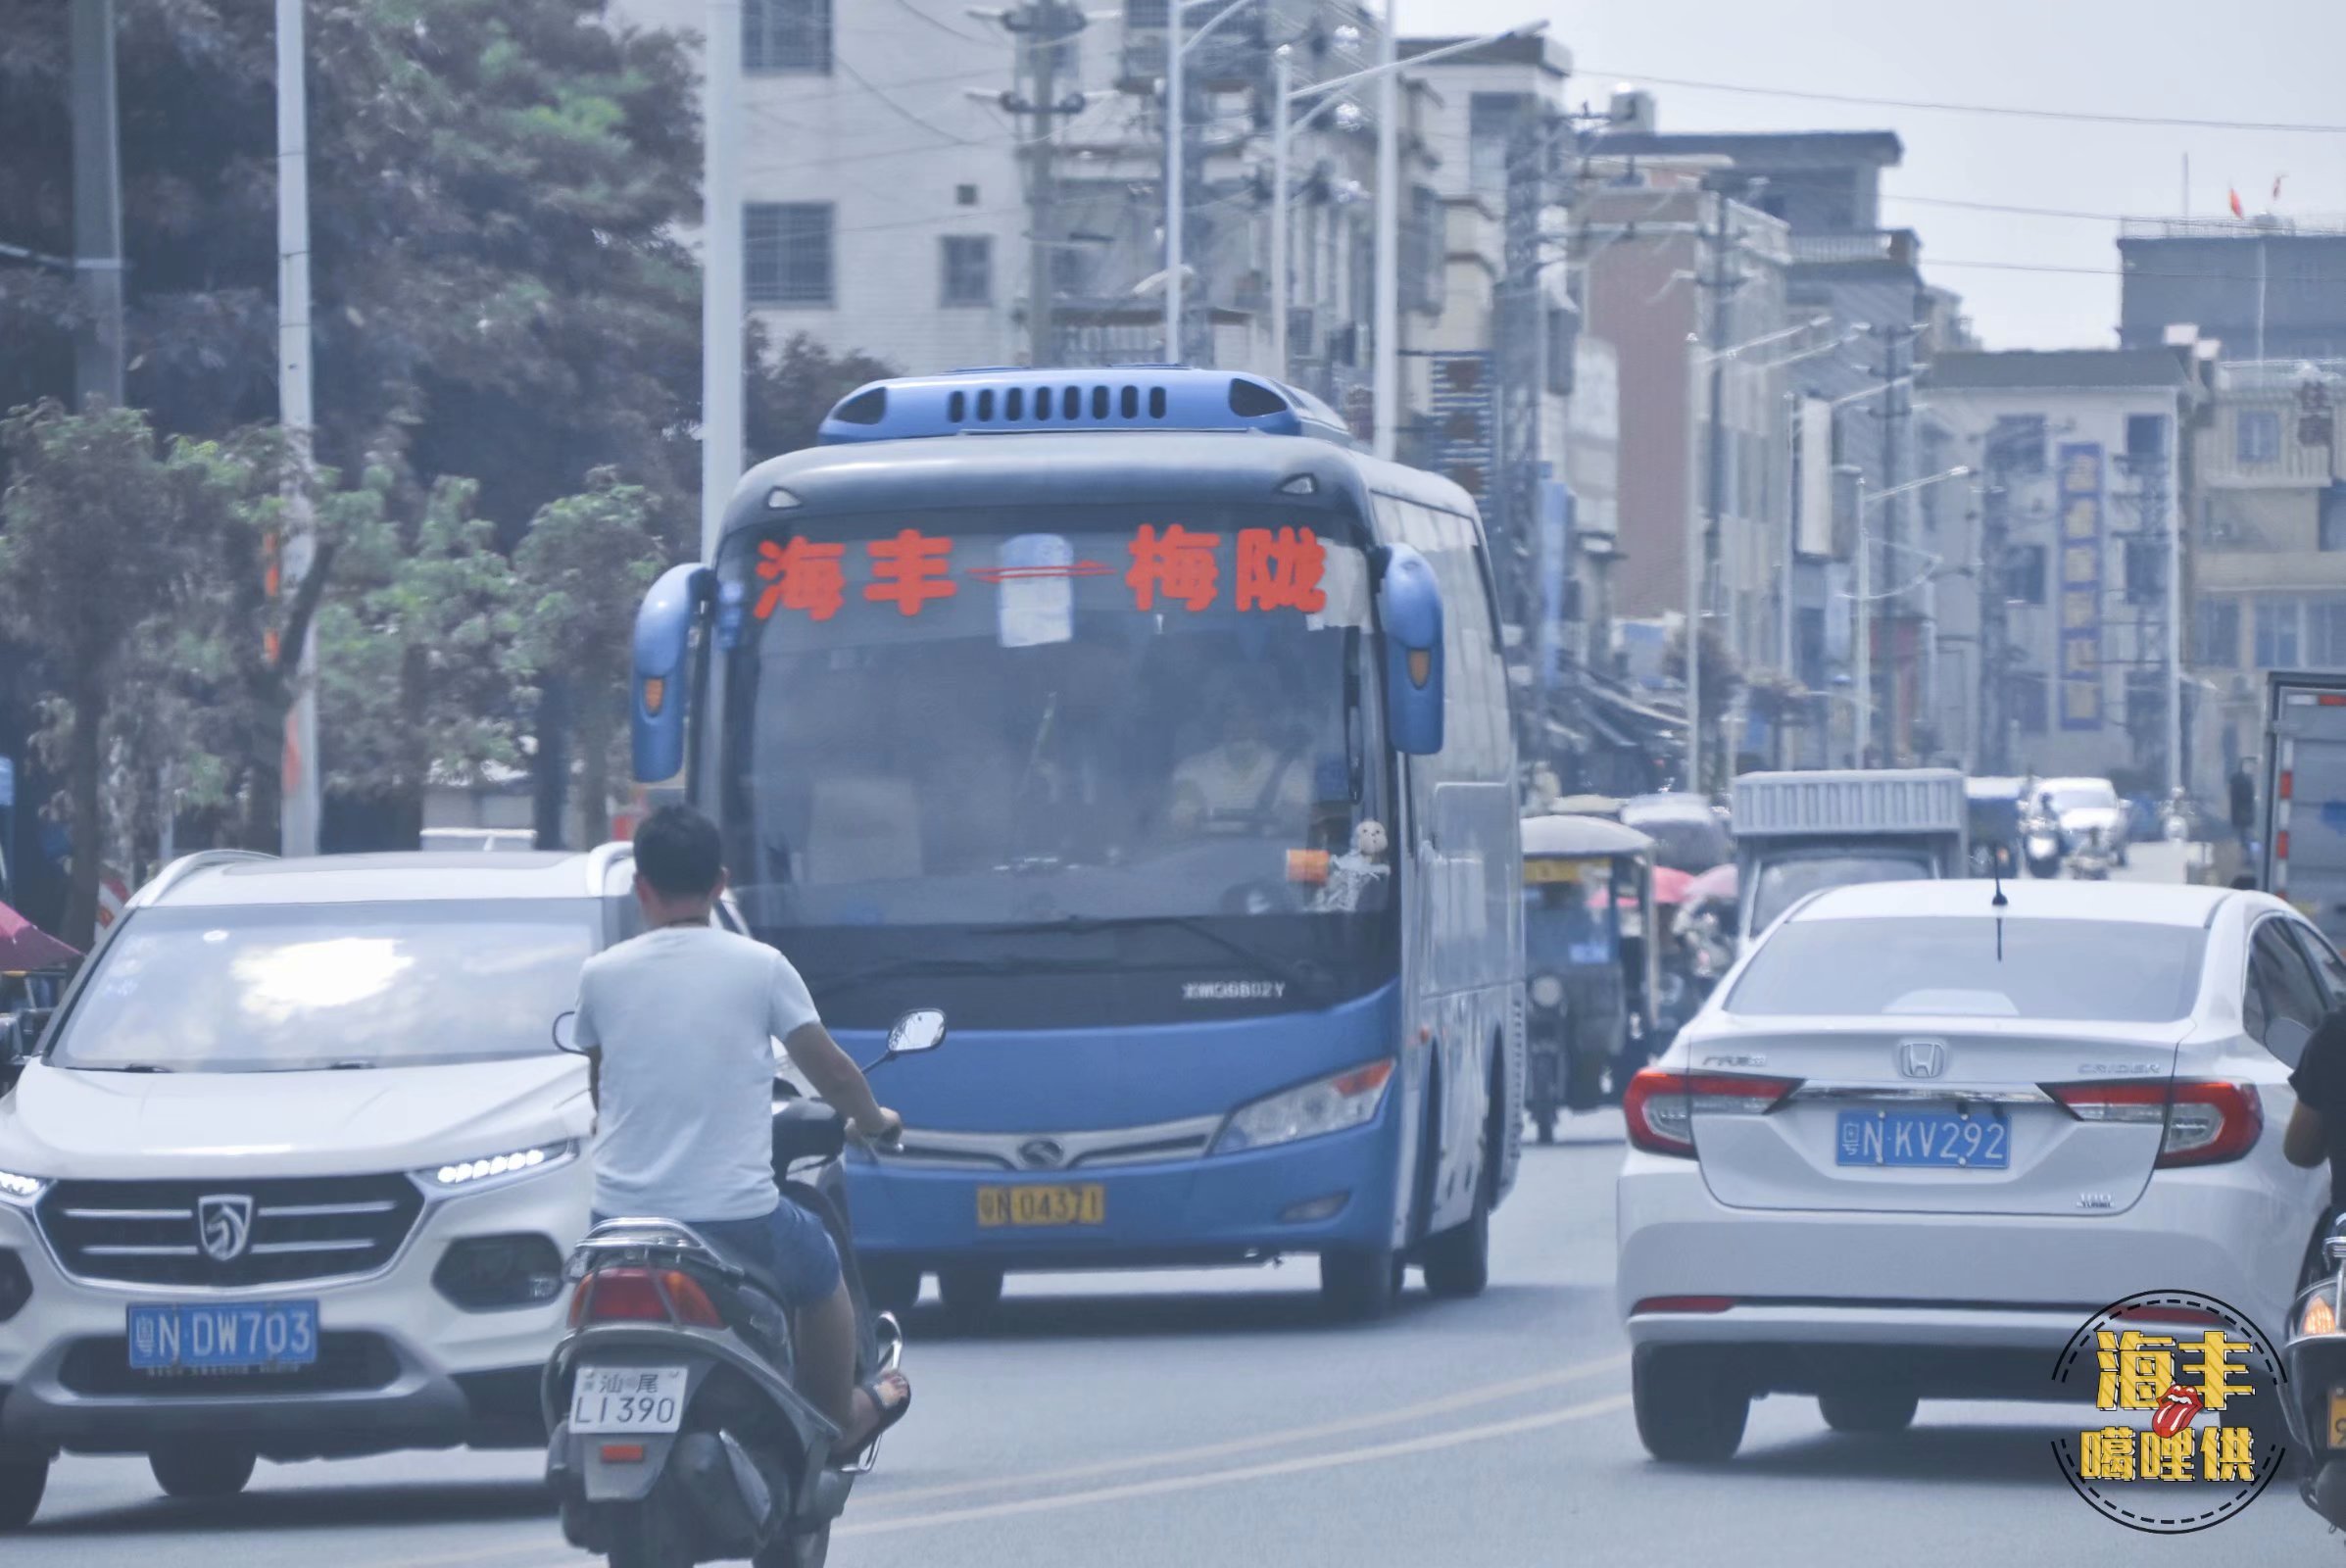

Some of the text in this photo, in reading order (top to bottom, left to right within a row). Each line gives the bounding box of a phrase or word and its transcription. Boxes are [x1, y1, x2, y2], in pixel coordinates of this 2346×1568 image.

[755, 523, 1327, 621] 海丰 梅陇
[575, 1396, 675, 1423] L1390
